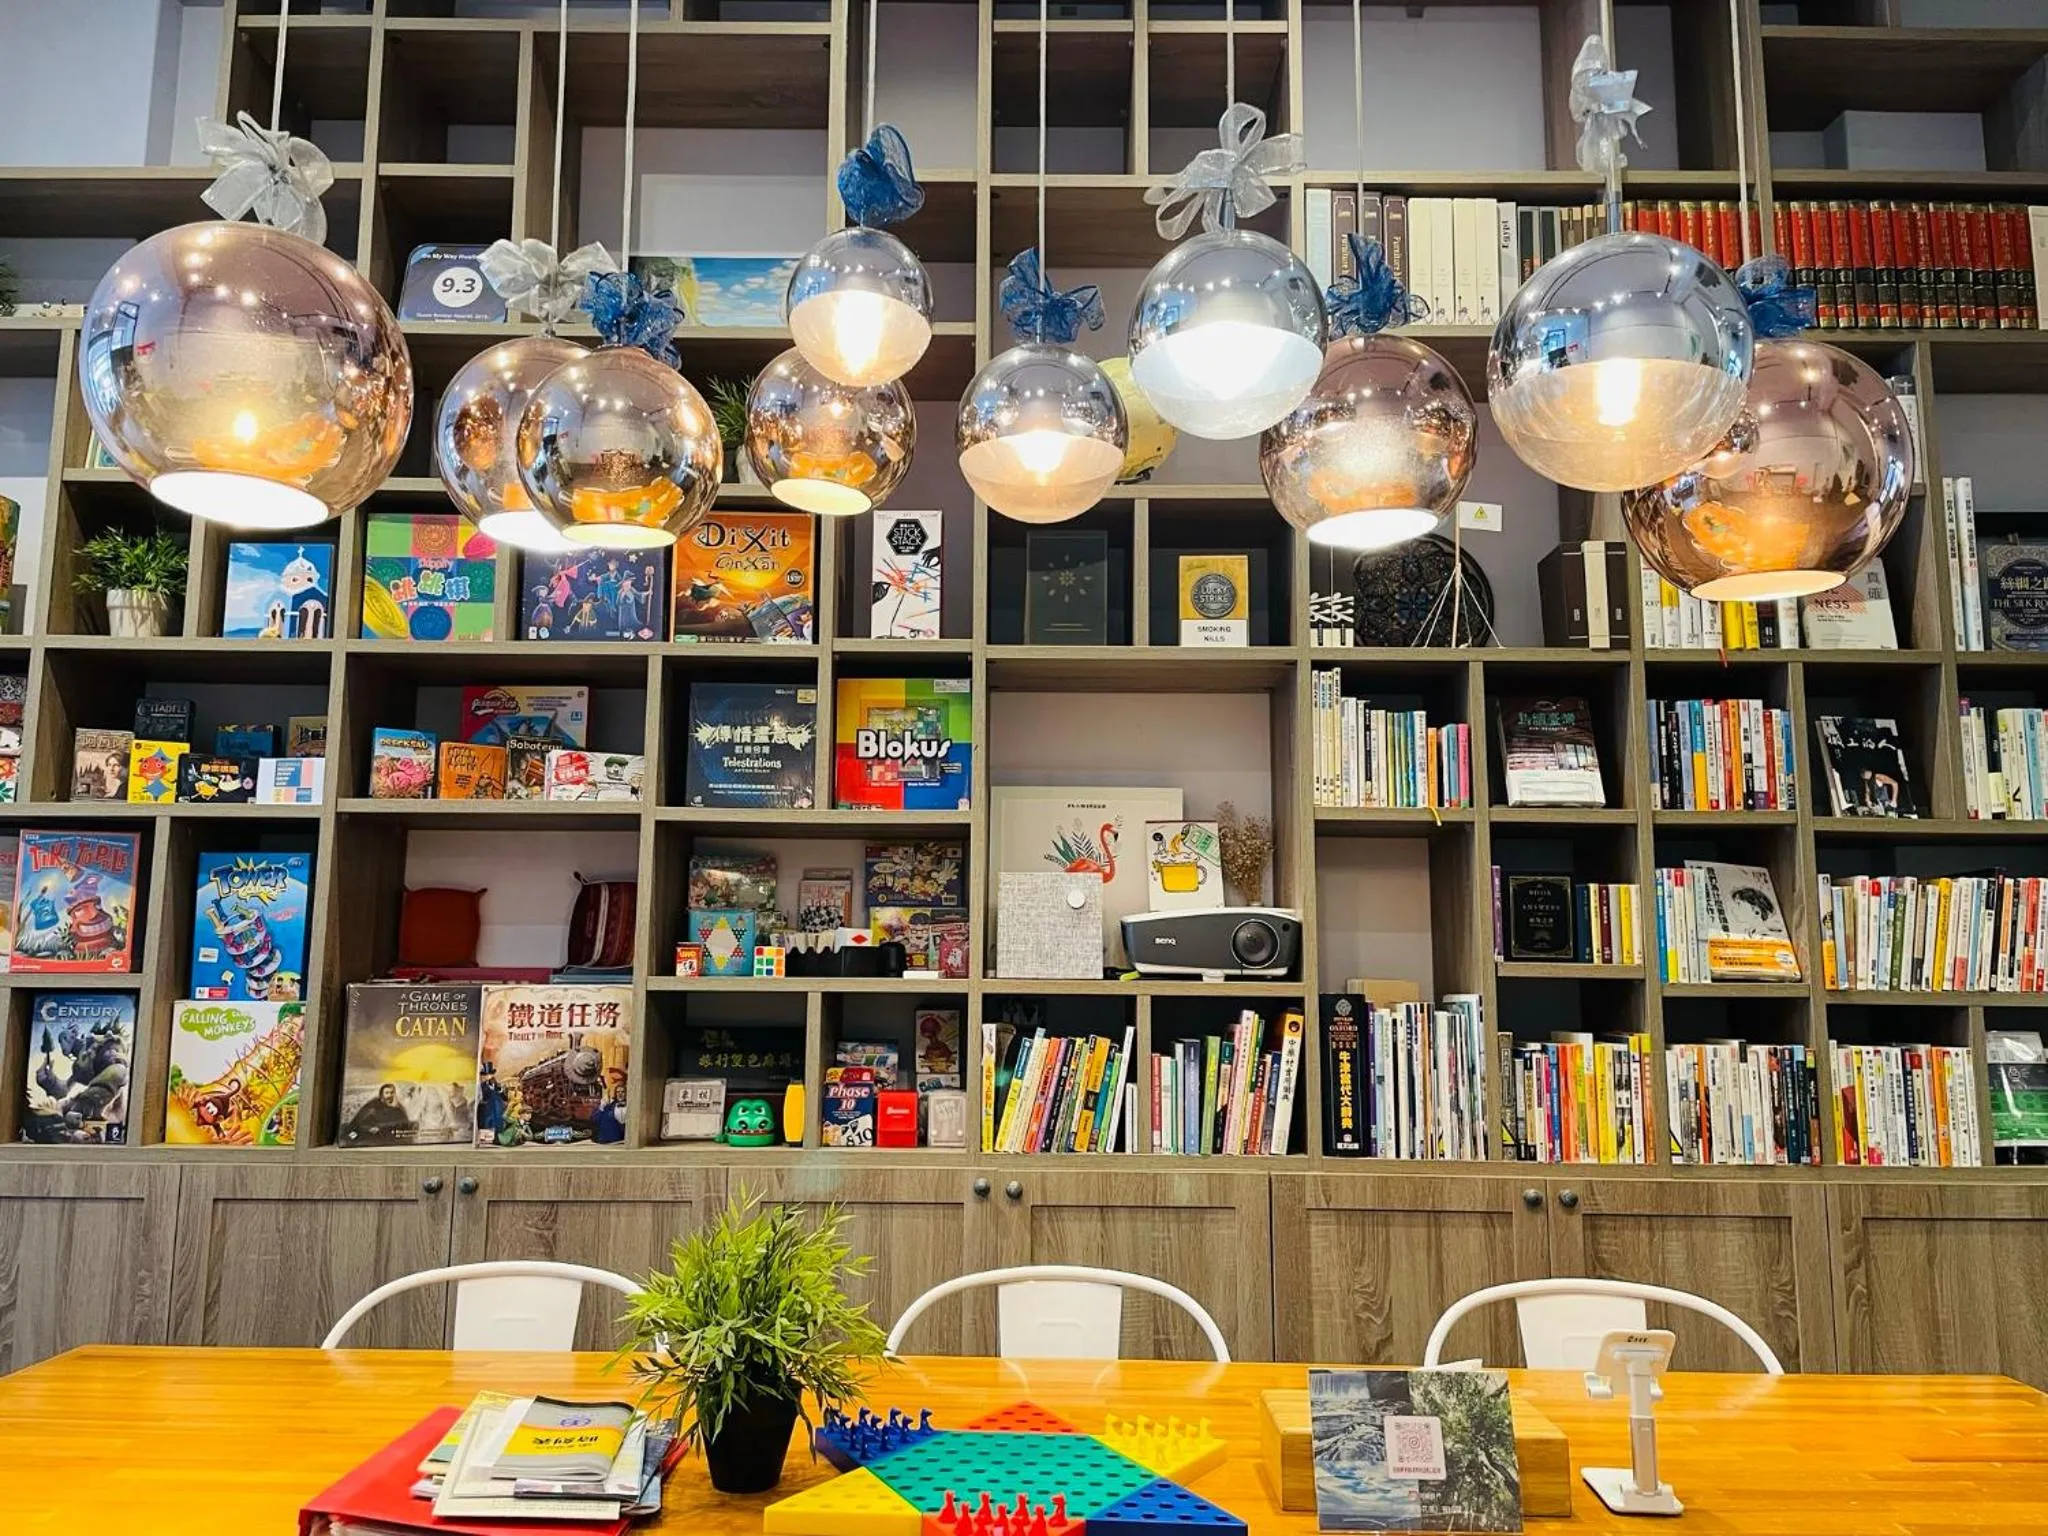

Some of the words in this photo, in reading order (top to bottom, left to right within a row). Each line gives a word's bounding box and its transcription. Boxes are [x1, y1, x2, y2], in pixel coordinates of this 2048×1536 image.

[441, 278, 476, 293] 9.3
[893, 528, 920, 536] STICK
[892, 536, 921, 545] STACK
[390, 569, 469, 602] 跳跳棋
[1201, 586, 1229, 595] LUCKY
[1199, 594, 1229, 603] STRIKE
[1814, 599, 1850, 610] NESS
[857, 730, 951, 762] Blokus
[722, 757, 782, 769] Telestrations
[210, 866, 288, 896] TOWER
[679, 949, 697, 958] UNO
[409, 991, 450, 1002] GAME
[452, 993, 466, 1001] OF
[40, 1001, 121, 1020] CENTURY
[398, 1001, 468, 1015] THRONES
[181, 1012, 227, 1024] FALLING
[508, 1002, 620, 1029] 鐵道任務
[203, 1019, 256, 1036] MONKEYS
[395, 1016, 467, 1037] CATAN
[839, 1099, 856, 1111] 10
